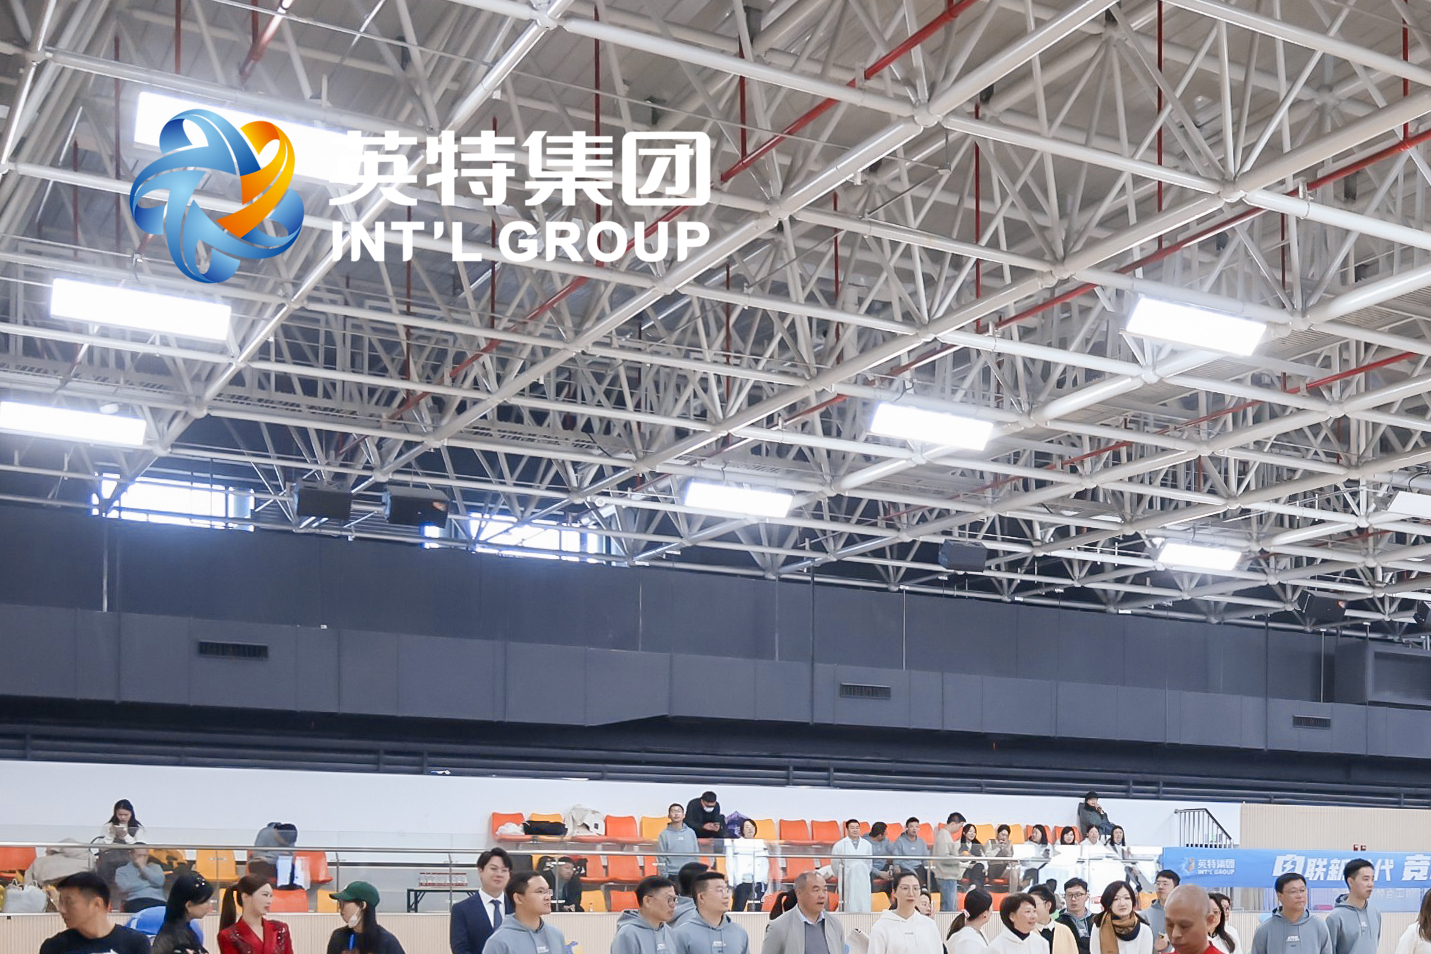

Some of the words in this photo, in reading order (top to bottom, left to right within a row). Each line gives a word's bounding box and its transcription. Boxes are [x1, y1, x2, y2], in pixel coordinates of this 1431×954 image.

[1197, 859, 1236, 869] 英特集团
[1272, 854, 1394, 882] 电联新代
